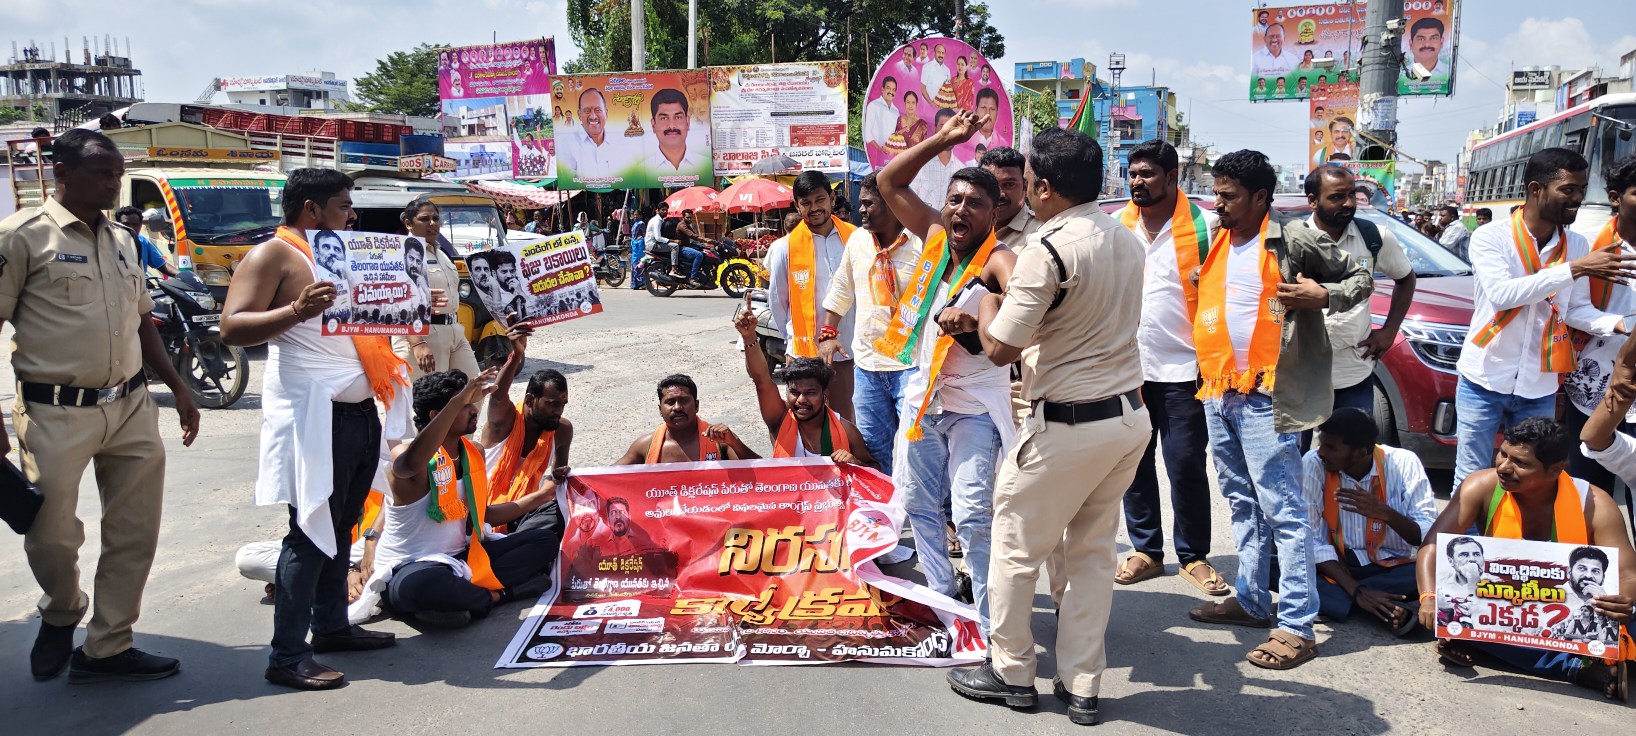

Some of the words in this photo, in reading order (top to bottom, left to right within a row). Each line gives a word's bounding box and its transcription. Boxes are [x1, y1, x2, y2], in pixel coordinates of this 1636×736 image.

[348, 236, 372, 250] యూత్
[374, 236, 400, 252] డిక్లరేషన్
[350, 260, 378, 272] తెలంగాణ
[380, 262, 404, 272] యువతకు
[543, 246, 588, 270] బకాయిలు
[910, 260, 932, 308] BJYM
[364, 326, 408, 334] HANUMAKONDA
[1553, 332, 1568, 342] BJP
[646, 486, 678, 498] యూత్
[680, 483, 718, 498] డిక్లరేషన్
[755, 482, 798, 492] తెలంగాణ
[718, 522, 852, 576] నిరస
[598, 558, 618, 570] యూత్
[1476, 579, 1567, 606] స్కూటీలు
[566, 642, 655, 657] భారతీయ
[658, 640, 718, 655] జనతా
[750, 640, 812, 658] మోర్చా
[1470, 630, 1496, 640] BJYM
[1504, 634, 1580, 651] HANUMAKONDA
